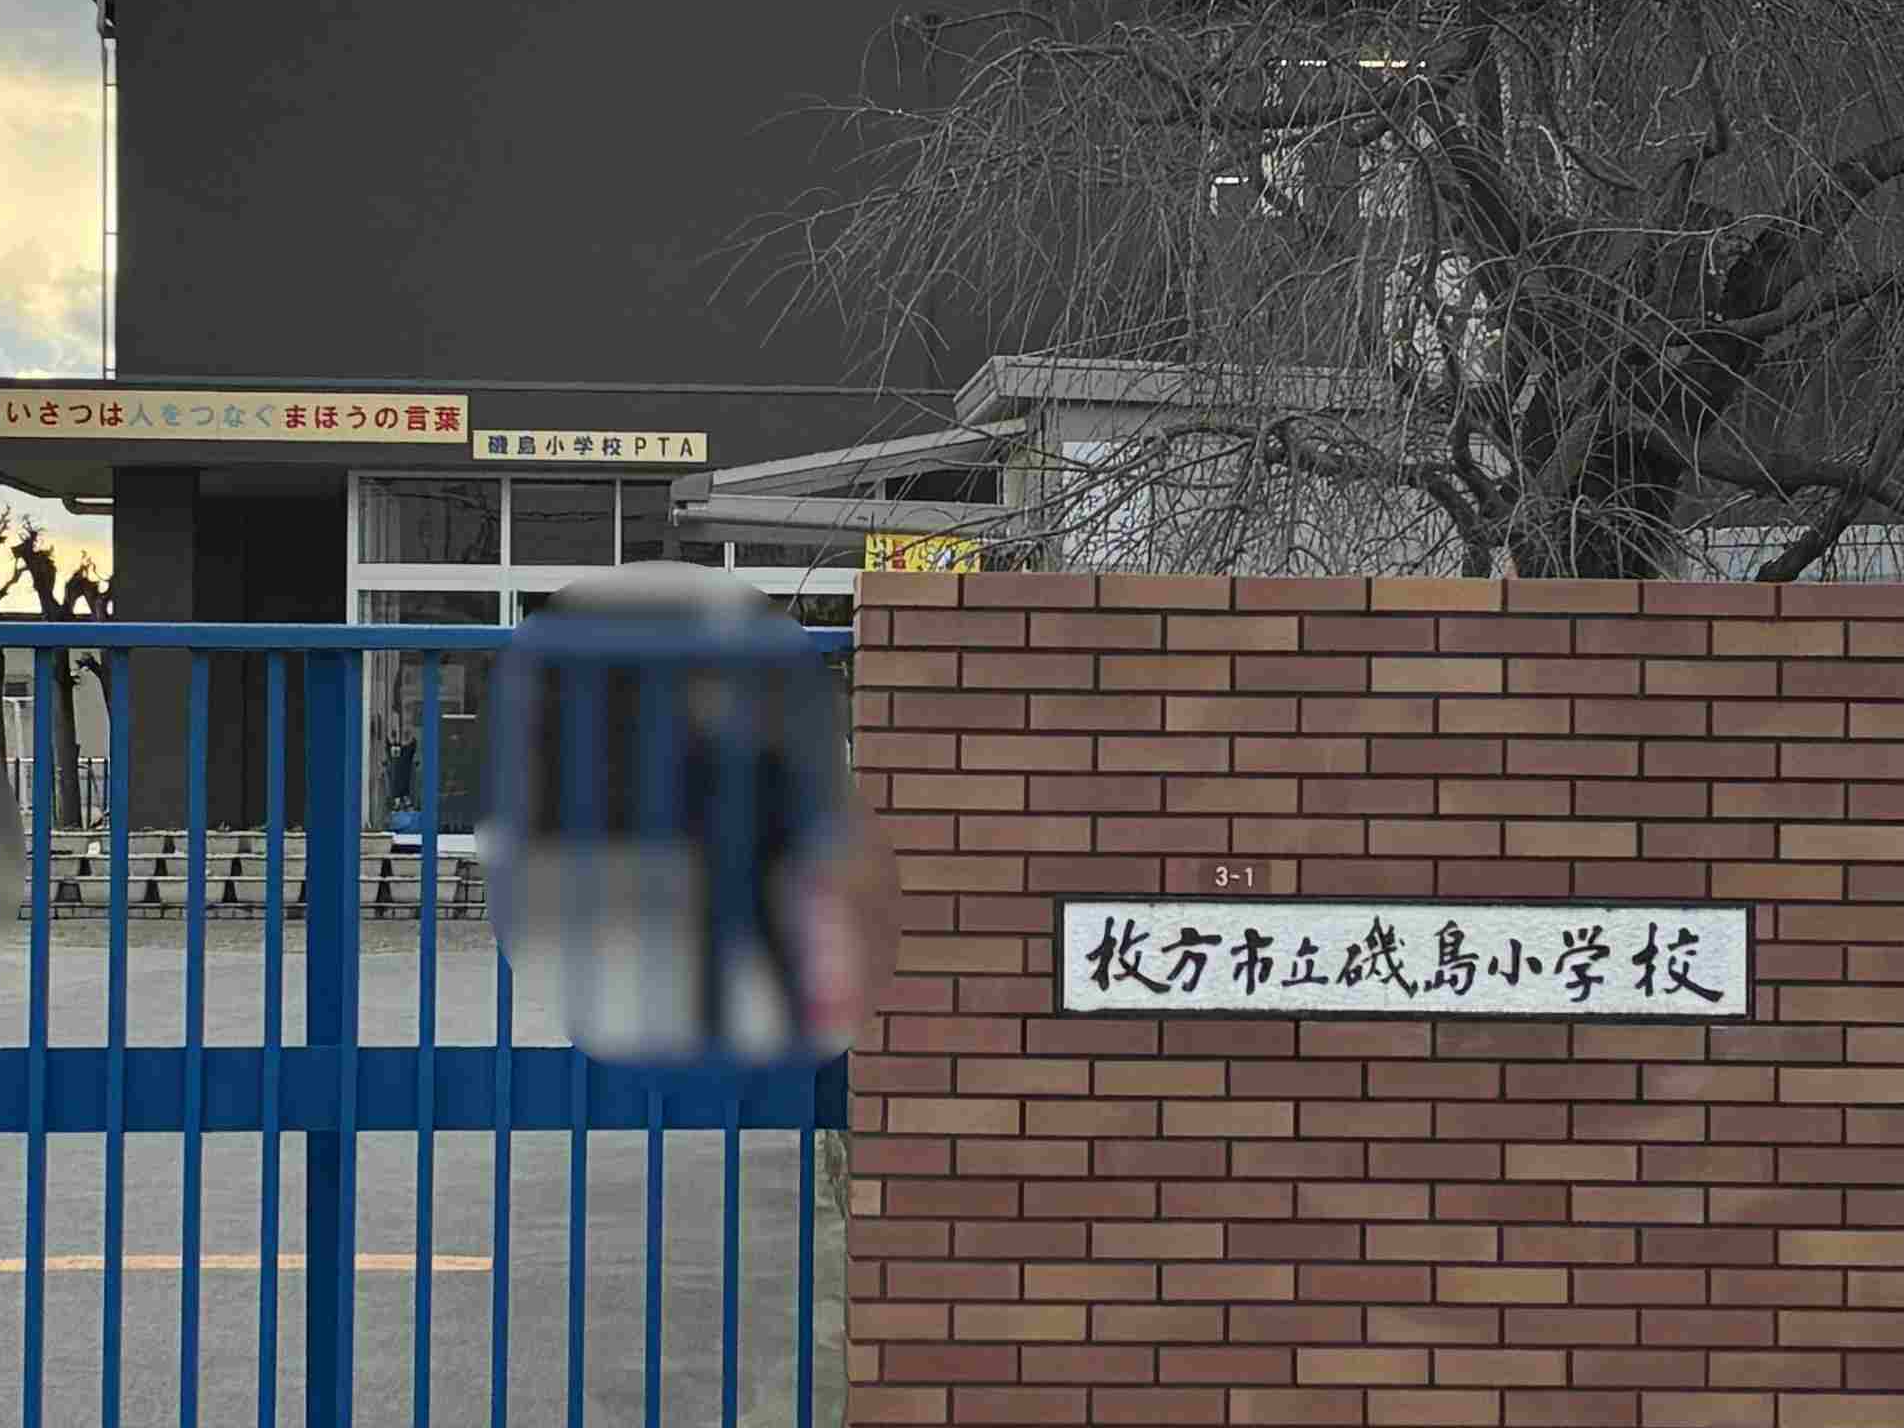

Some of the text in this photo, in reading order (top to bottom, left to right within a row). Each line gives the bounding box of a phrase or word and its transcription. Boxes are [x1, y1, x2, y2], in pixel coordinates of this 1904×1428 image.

[1216, 866, 1253, 887] 3-1
[1086, 915, 1725, 1004] 枚方市立磯島小学校
